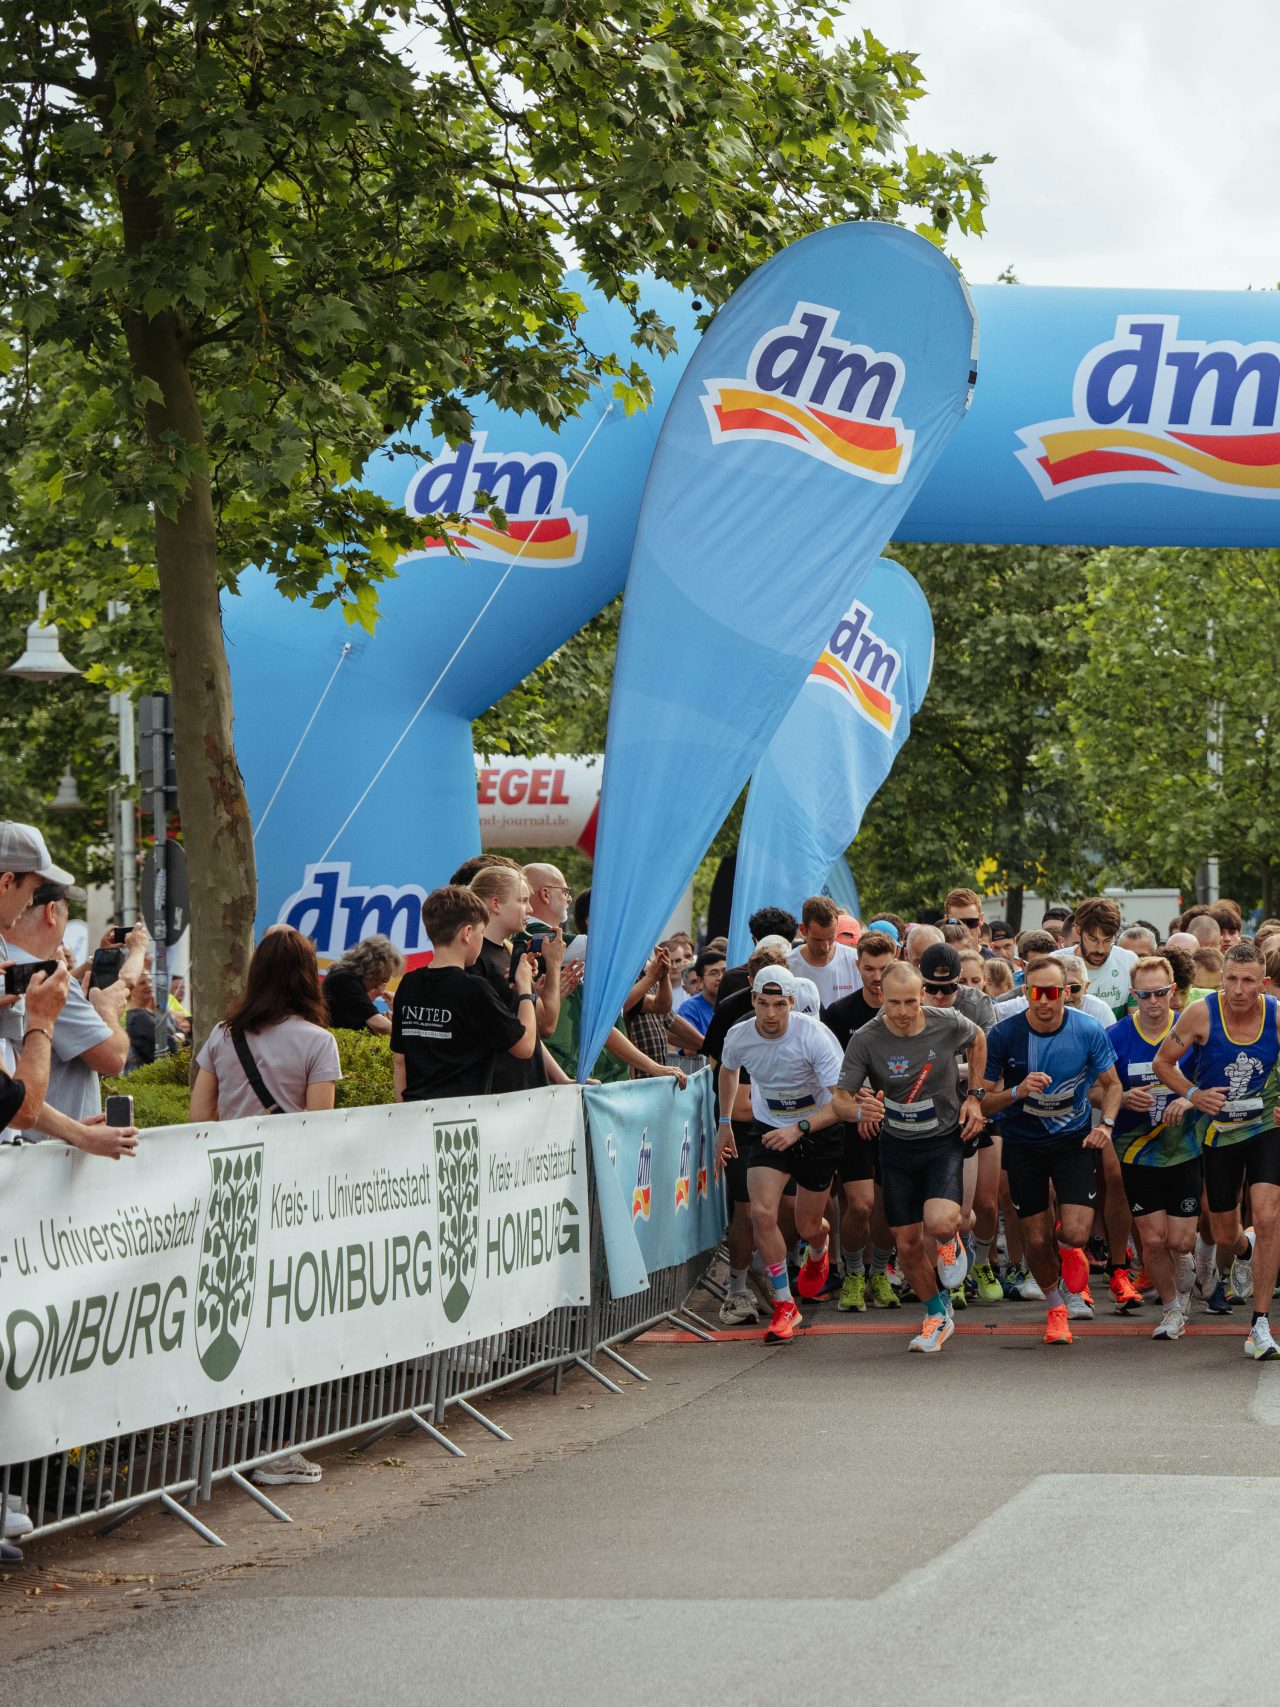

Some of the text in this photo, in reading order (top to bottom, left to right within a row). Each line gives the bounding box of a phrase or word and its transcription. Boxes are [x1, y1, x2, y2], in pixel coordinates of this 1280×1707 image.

[756, 312, 897, 421] dm
[414, 440, 558, 515] dm
[829, 607, 896, 693] dm
[286, 871, 421, 951] dm
[271, 1163, 431, 1229] Kreis- u. Universitätsstadt
[488, 1152, 513, 1194] Kreis-
[637, 1133, 652, 1187] dm
[14, 1237, 38, 1276] u.
[40, 1197, 201, 1270] Universitätsstadt
[266, 1230, 432, 1328] HOMBURG
[0, 1275, 188, 1391] OMBURG
